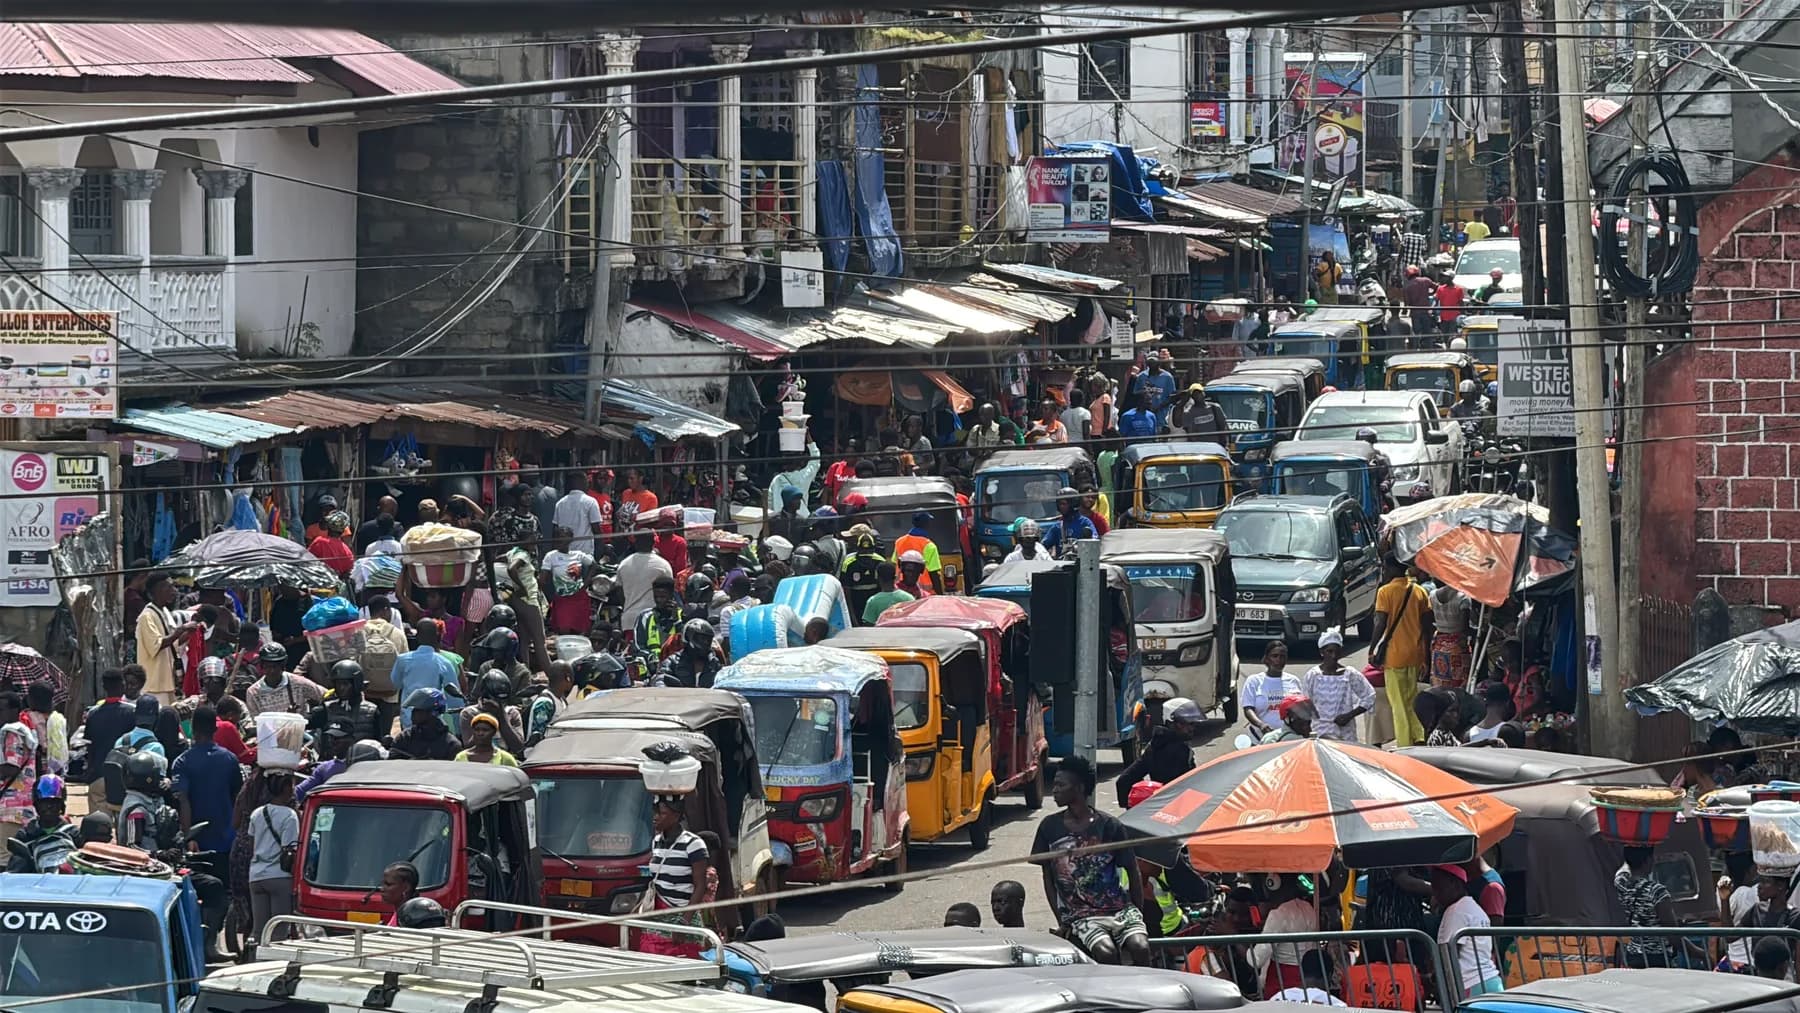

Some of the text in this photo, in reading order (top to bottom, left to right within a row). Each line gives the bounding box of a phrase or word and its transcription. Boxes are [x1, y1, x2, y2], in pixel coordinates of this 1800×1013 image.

[32, 313, 111, 330] ENTERPRISES
[1510, 399, 1537, 407] moving
[1540, 399, 1564, 408] money
[14, 465, 44, 479] BnB
[60, 508, 93, 526] Ri
[8, 526, 50, 538] AFRO
[769, 776, 820, 784] LUCKY DAY
[1370, 820, 1411, 831] orange
